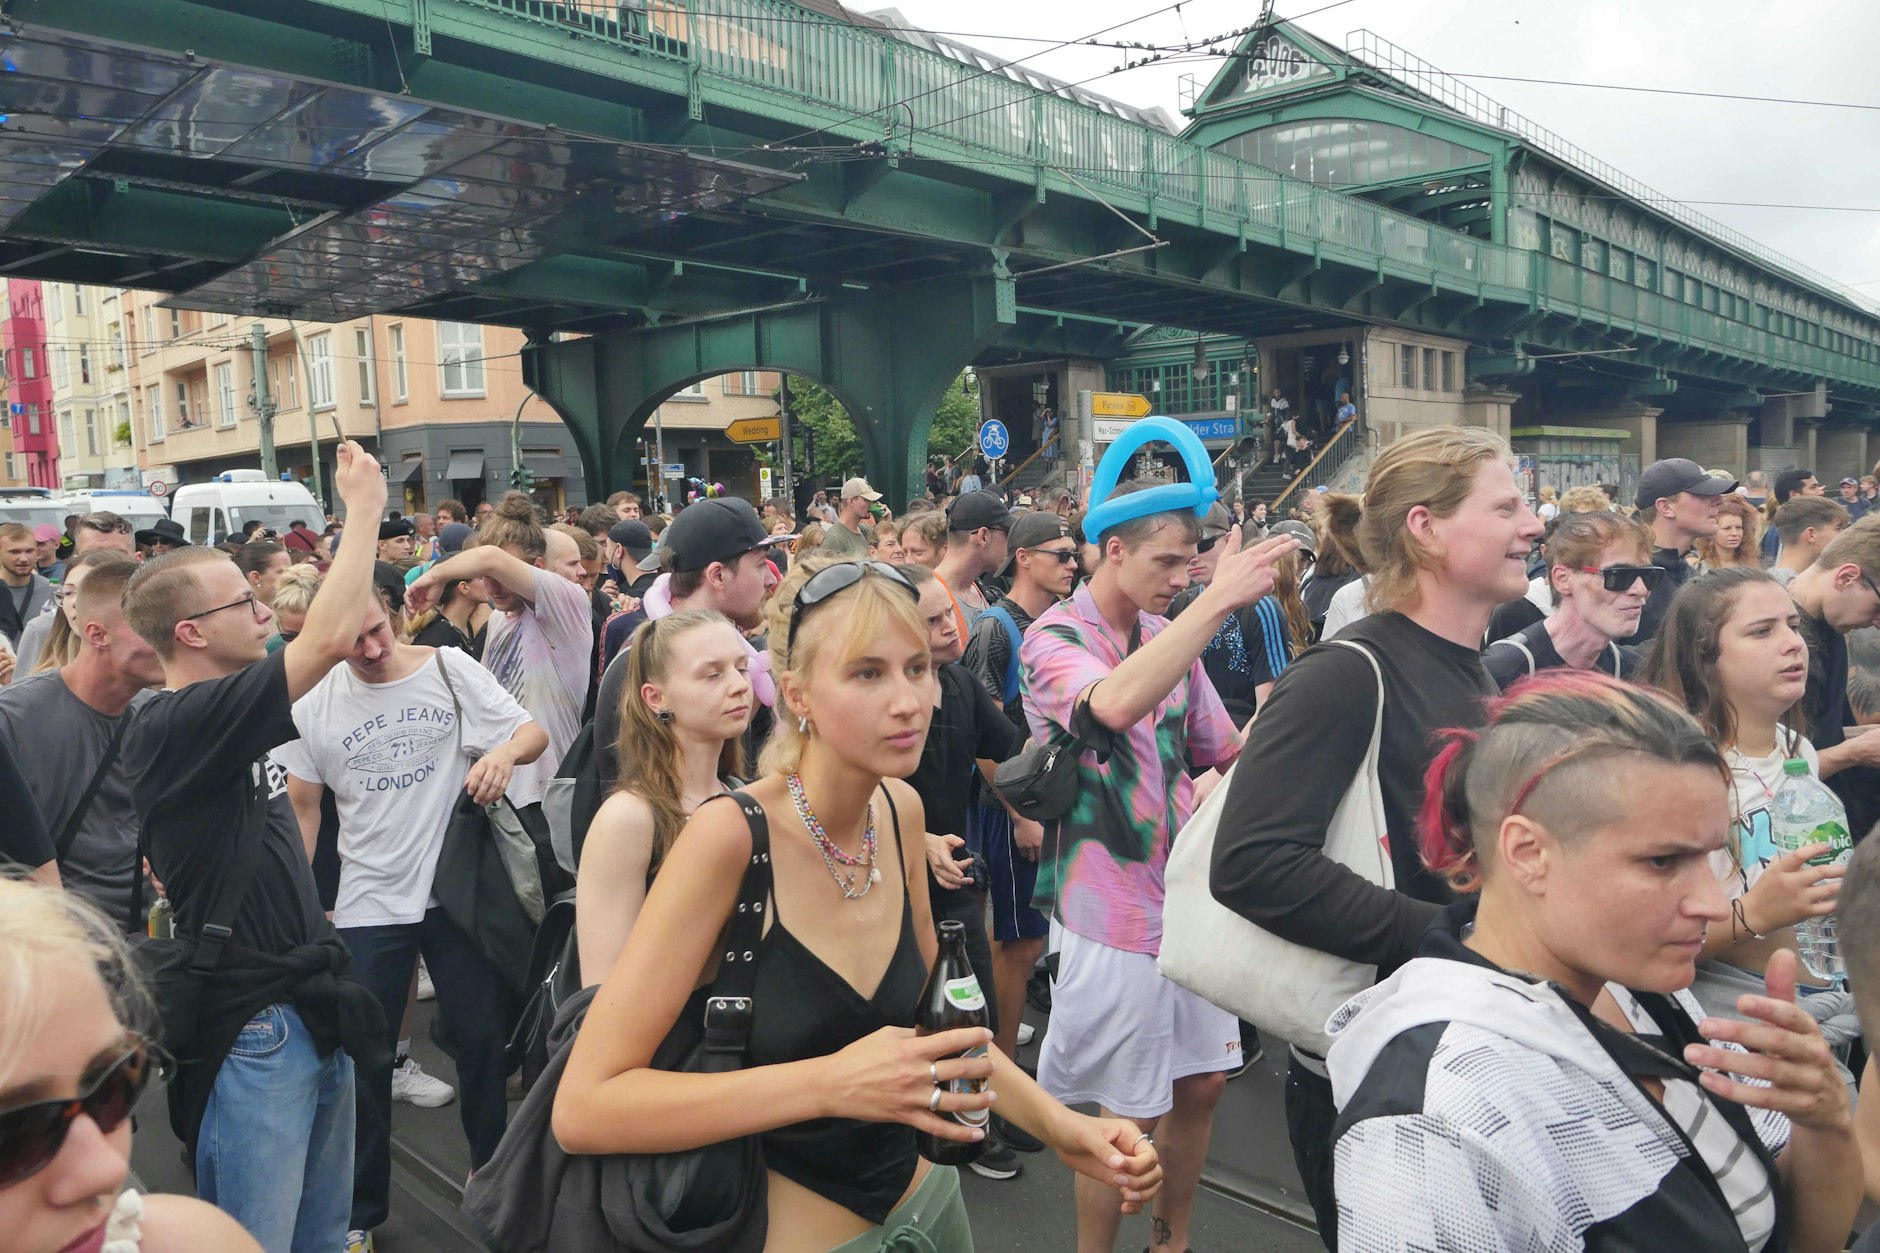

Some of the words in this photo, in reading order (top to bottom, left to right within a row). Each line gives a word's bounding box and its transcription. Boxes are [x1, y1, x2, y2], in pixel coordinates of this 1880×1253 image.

[1102, 400, 1125, 409] Pankow
[742, 426, 769, 436] Wedding
[1190, 424, 1210, 435] lder
[1212, 422, 1234, 435] Stra
[153, 484, 164, 492] 30
[342, 714, 387, 751] PEPE
[397, 708, 454, 725] JEANS
[384, 729, 407, 740] DENIM
[408, 728, 433, 736] BRAND
[353, 755, 371, 765] PEPE
[390, 739, 414, 759] 73
[415, 738, 438, 749] JEANS
[376, 763, 404, 771] QUALITY
[405, 754, 429, 767] GOODS
[365, 761, 435, 791] LONDON
